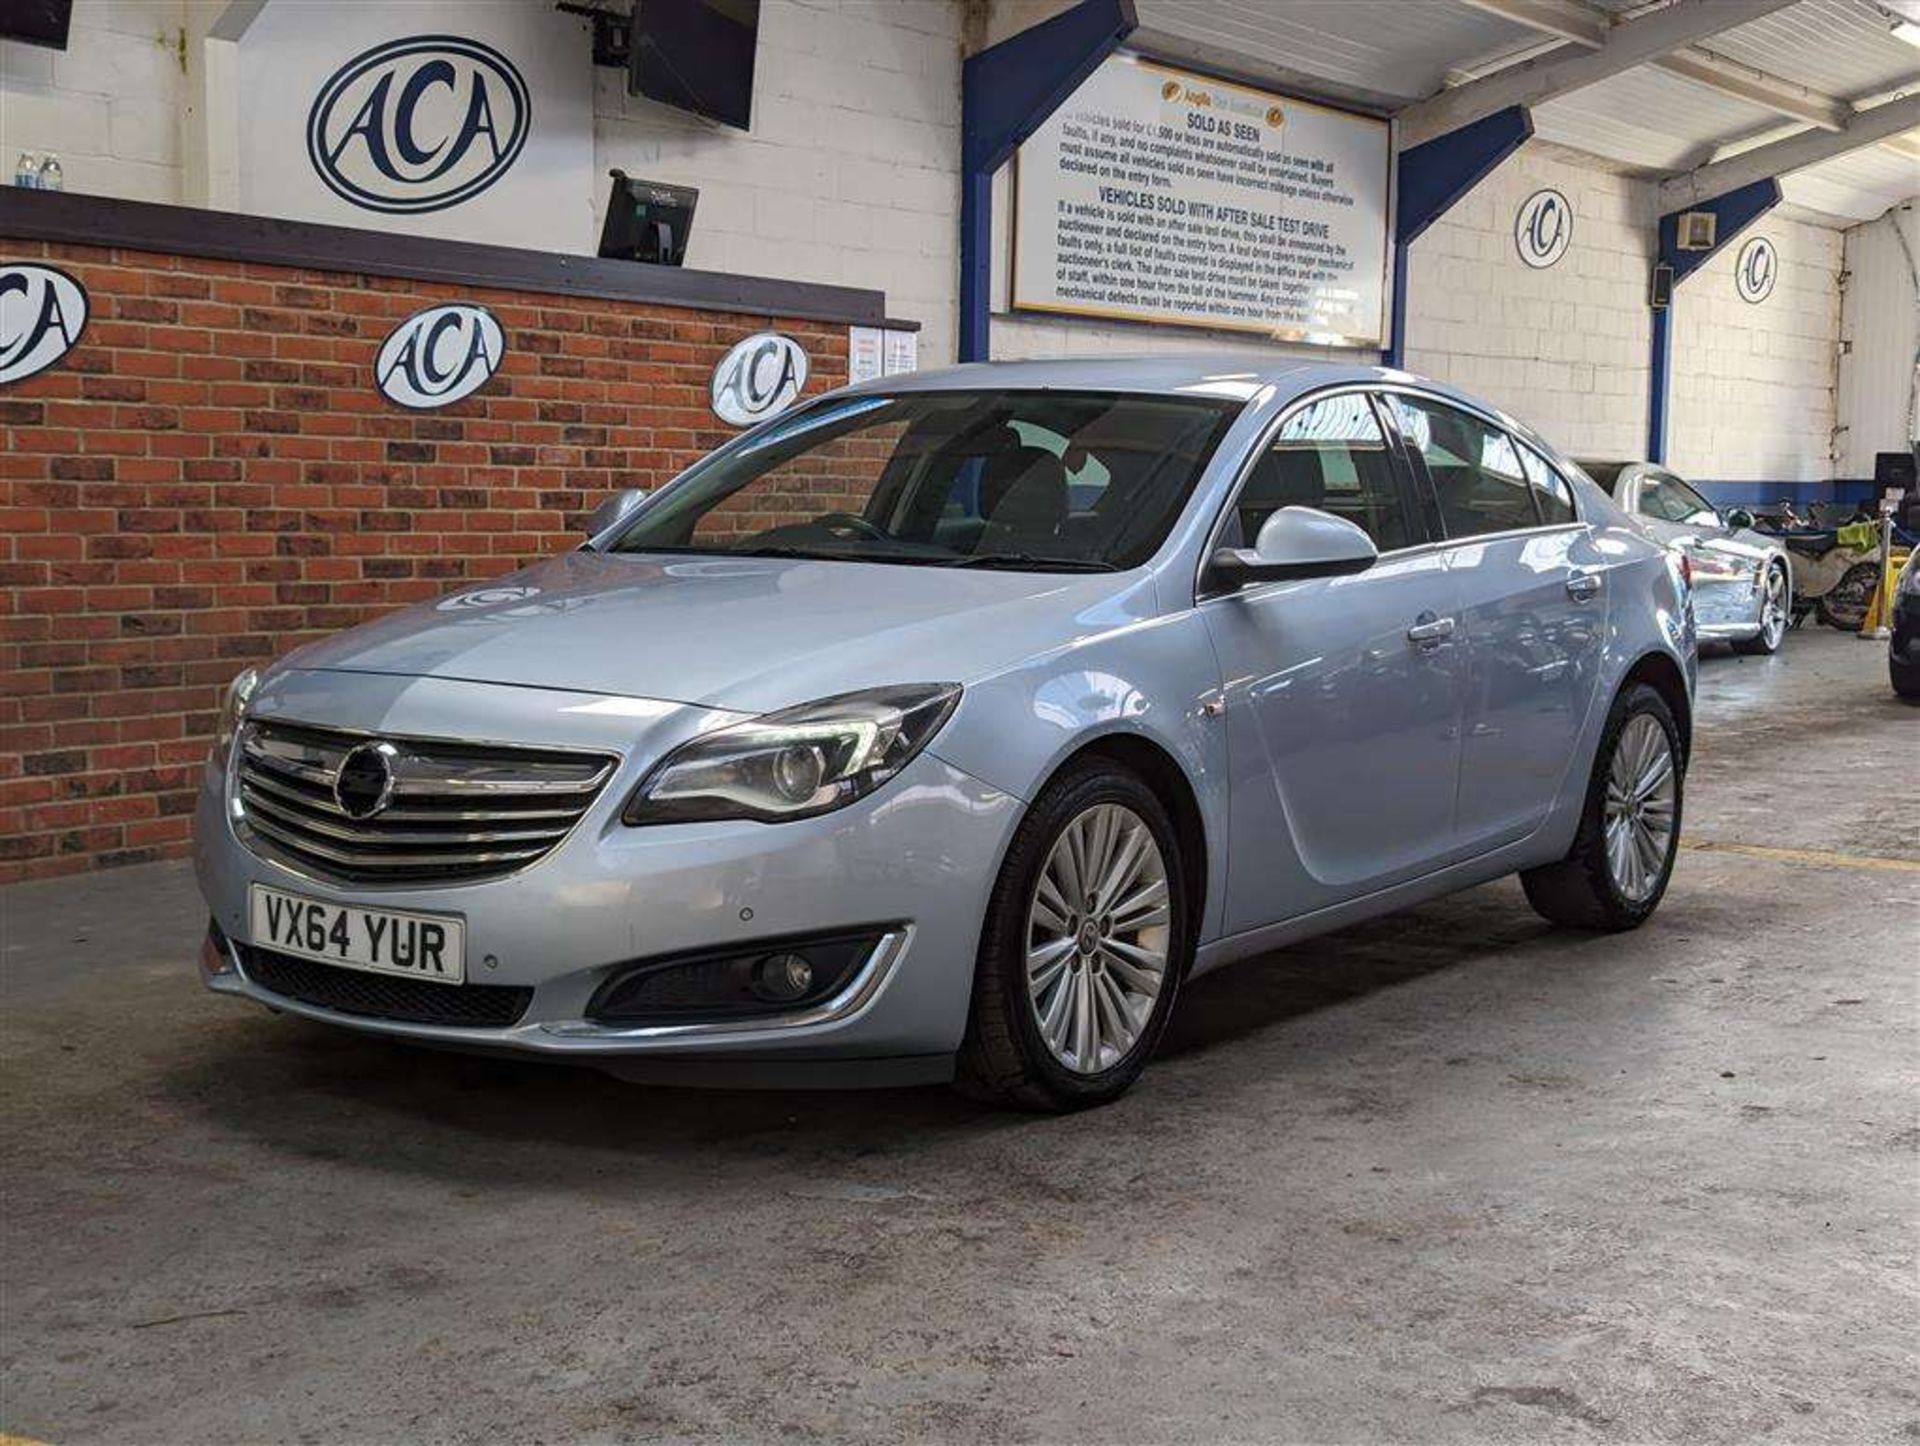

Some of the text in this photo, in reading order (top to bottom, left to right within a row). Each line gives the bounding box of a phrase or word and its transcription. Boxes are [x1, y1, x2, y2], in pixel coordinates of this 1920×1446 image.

[328, 58, 504, 184] ACA
[1187, 112, 1261, 142] SOLD AS SEEN
[1059, 139, 1081, 155] must
[1083, 146, 1117, 162] assume
[1119, 151, 1130, 164] all
[1132, 153, 1165, 171] vehicles
[1167, 160, 1184, 174] sold
[1185, 166, 1195, 176] as
[1196, 168, 1214, 180] seen
[1216, 169, 1233, 183] have
[1235, 173, 1268, 190] incorrect
[1270, 180, 1297, 198] mileage
[1298, 185, 1320, 199] unless
[1059, 156, 1171, 187] declared on the entry form.
[1062, 123, 1089, 140] faults,
[1091, 129, 1098, 141] if
[1119, 134, 1135, 148] and
[1136, 140, 1148, 151] no
[1149, 140, 1192, 162] complaints
[1195, 149, 1236, 168] whatsoever
[1238, 158, 1256, 172] shall
[1257, 162, 1267, 174] be
[1311, 173, 1333, 190] Buyers
[1174, 131, 1182, 142] or
[1184, 131, 1201, 146] less
[1202, 137, 1214, 148] are
[1216, 138, 1263, 161] automatically
[1265, 149, 1280, 162] sold
[1282, 154, 1292, 164] as
[1292, 156, 1309, 168] seen
[1310, 158, 1324, 171] with
[1325, 161, 1333, 173] all
[1058, 199, 1346, 257] If a vehicle is sold with an after sale test drive, this shall be announced by the
[1098, 186, 1328, 238] VEHICLES SOLD WITH AFTER SALE TEST DRIVE
[1522, 198, 1564, 256] ACA
[1056, 234, 1082, 248] faults
[1106, 243, 1112, 252] a
[1113, 242, 1127, 254] full
[1129, 244, 1142, 257] list
[1143, 246, 1152, 258] of
[1153, 247, 1175, 261] faults
[1177, 251, 1209, 265] covered
[1209, 255, 1216, 266] is
[1218, 256, 1254, 275] displayed
[1255, 261, 1262, 273] in
[1264, 263, 1275, 274] the
[1277, 265, 1296, 277] office
[1298, 267, 1310, 279] and
[1312, 269, 1325, 281] with
[1056, 251, 1109, 268] auctioneer's
[1110, 258, 1134, 271] clerk.
[1136, 261, 1152, 274] The
[1153, 263, 1172, 276] after
[1174, 266, 1189, 278] sale
[1190, 268, 1206, 280] test
[1207, 270, 1225, 283] drive
[1227, 273, 1246, 285] must
[1247, 276, 1256, 287] be
[1057, 217, 1103, 235] auctioneer
[1105, 224, 1122, 238] and
[1123, 227, 1158, 243] declared
[1160, 235, 1171, 245] on
[1172, 234, 1184, 247] the
[1186, 237, 1206, 253] entry
[1228, 243, 1235, 254] A
[1236, 244, 1250, 256] test
[1251, 246, 1270, 259] drive
[1271, 251, 1295, 263] covers
[1296, 255, 1316, 269] major
[1317, 256, 1354, 271] mechanical
[1743, 244, 1771, 294] ACA
[1056, 267, 1066, 280] of
[1067, 269, 1090, 284] staff,
[1092, 272, 1118, 286] within
[1119, 277, 1135, 288] one
[1136, 277, 1155, 290] hour
[1156, 279, 1175, 292] from
[1177, 282, 1189, 294] the
[1190, 284, 1203, 296] fall
[1205, 285, 1212, 297] of
[1213, 286, 1226, 298] the
[1260, 292, 1274, 307] Any
[1056, 284, 1105, 300] mechanical
[1106, 290, 1137, 304] defects
[1139, 294, 1160, 306] must
[1162, 296, 1171, 307] be
[1172, 297, 1206, 314] reported
[1208, 301, 1231, 314] within
[1232, 306, 1245, 315] one
[1247, 306, 1263, 317] hour
[1265, 307, 1281, 319] from
[1283, 309, 1294, 320] the
[379, 312, 494, 395] ACA
[718, 340, 805, 413] ACA
[265, 895, 446, 972] VX64 YUR
